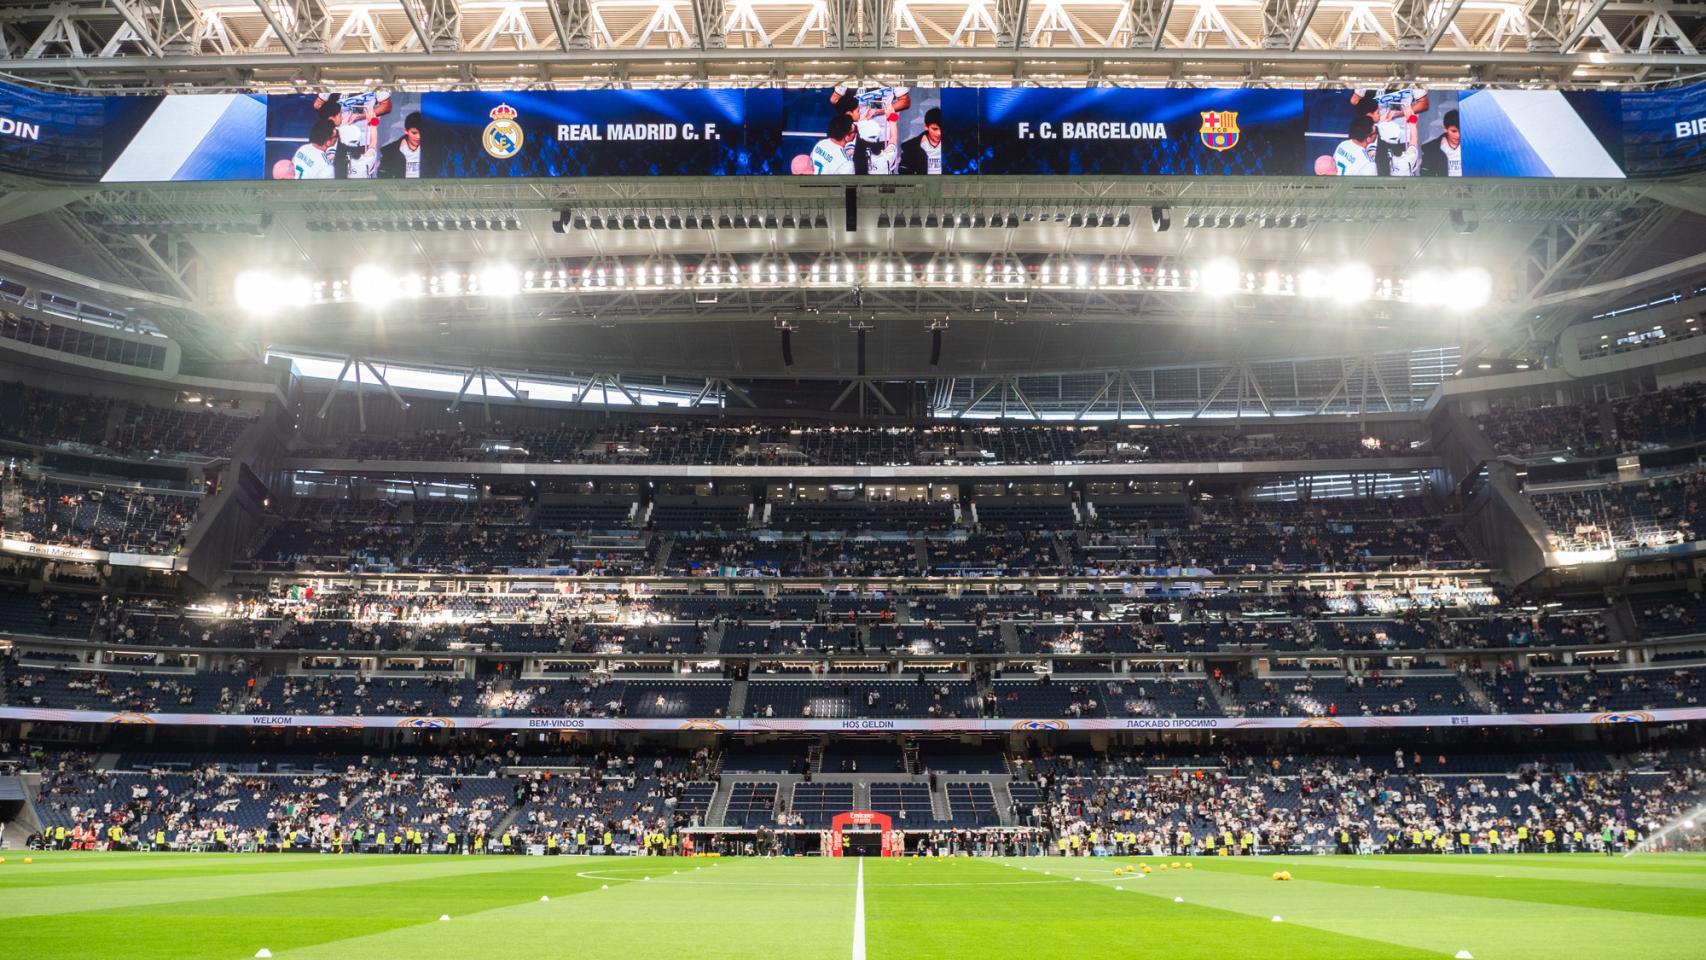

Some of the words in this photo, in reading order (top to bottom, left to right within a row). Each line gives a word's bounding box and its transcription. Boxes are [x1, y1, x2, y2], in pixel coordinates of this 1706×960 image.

[558, 124, 602, 141] REAL
[607, 123, 677, 140] MADRID
[682, 123, 699, 140] C.
[704, 123, 721, 140] F.
[1018, 122, 1035, 139] F.
[1039, 122, 1057, 139] C.
[1062, 122, 1167, 139] BARCELONA
[29, 545, 49, 554] Real
[52, 548, 83, 558] Madrid
[253, 716, 292, 724] WELKOM
[529, 719, 585, 727] BEM-VINDOS
[862, 720, 894, 728] GELDIN
[1127, 720, 1170, 728] ЛАСКАВО
[1172, 719, 1217, 727] ПРОСИМО
